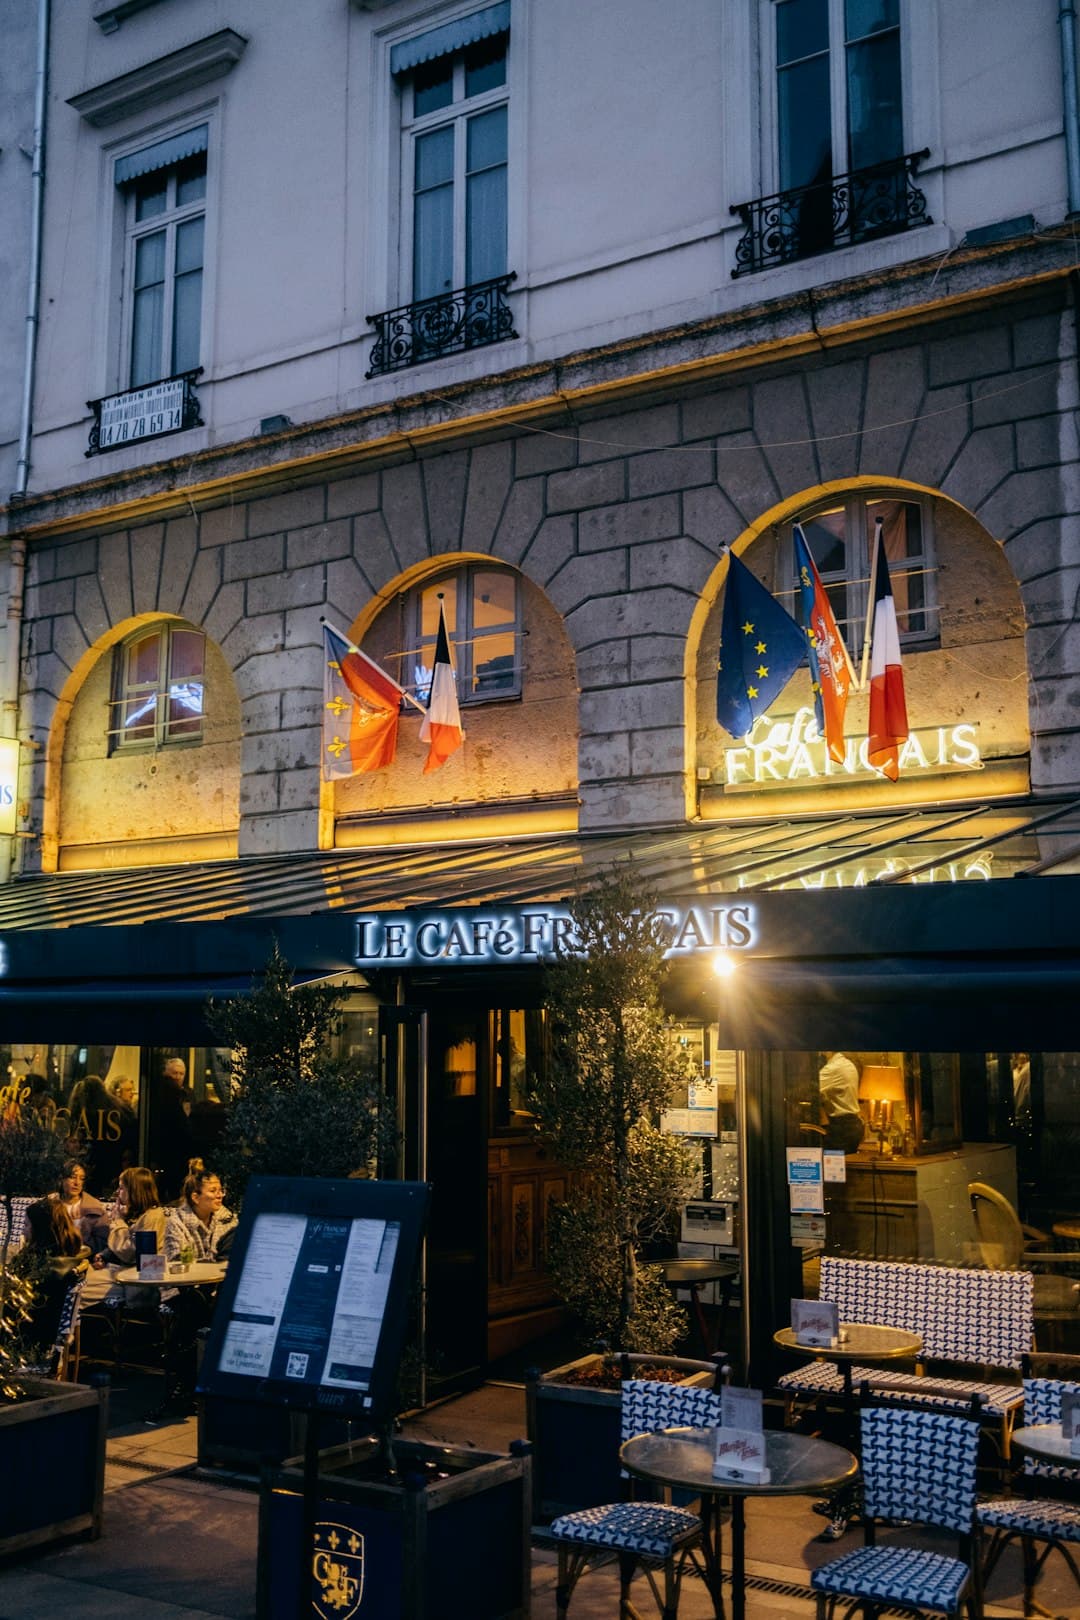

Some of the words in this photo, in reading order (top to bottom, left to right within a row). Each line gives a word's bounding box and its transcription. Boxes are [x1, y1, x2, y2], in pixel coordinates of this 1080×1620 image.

[100, 426, 112, 446] 04
[115, 422, 128, 442] 78
[150, 413, 163, 433] 69
[356, 920, 407, 960] LE
